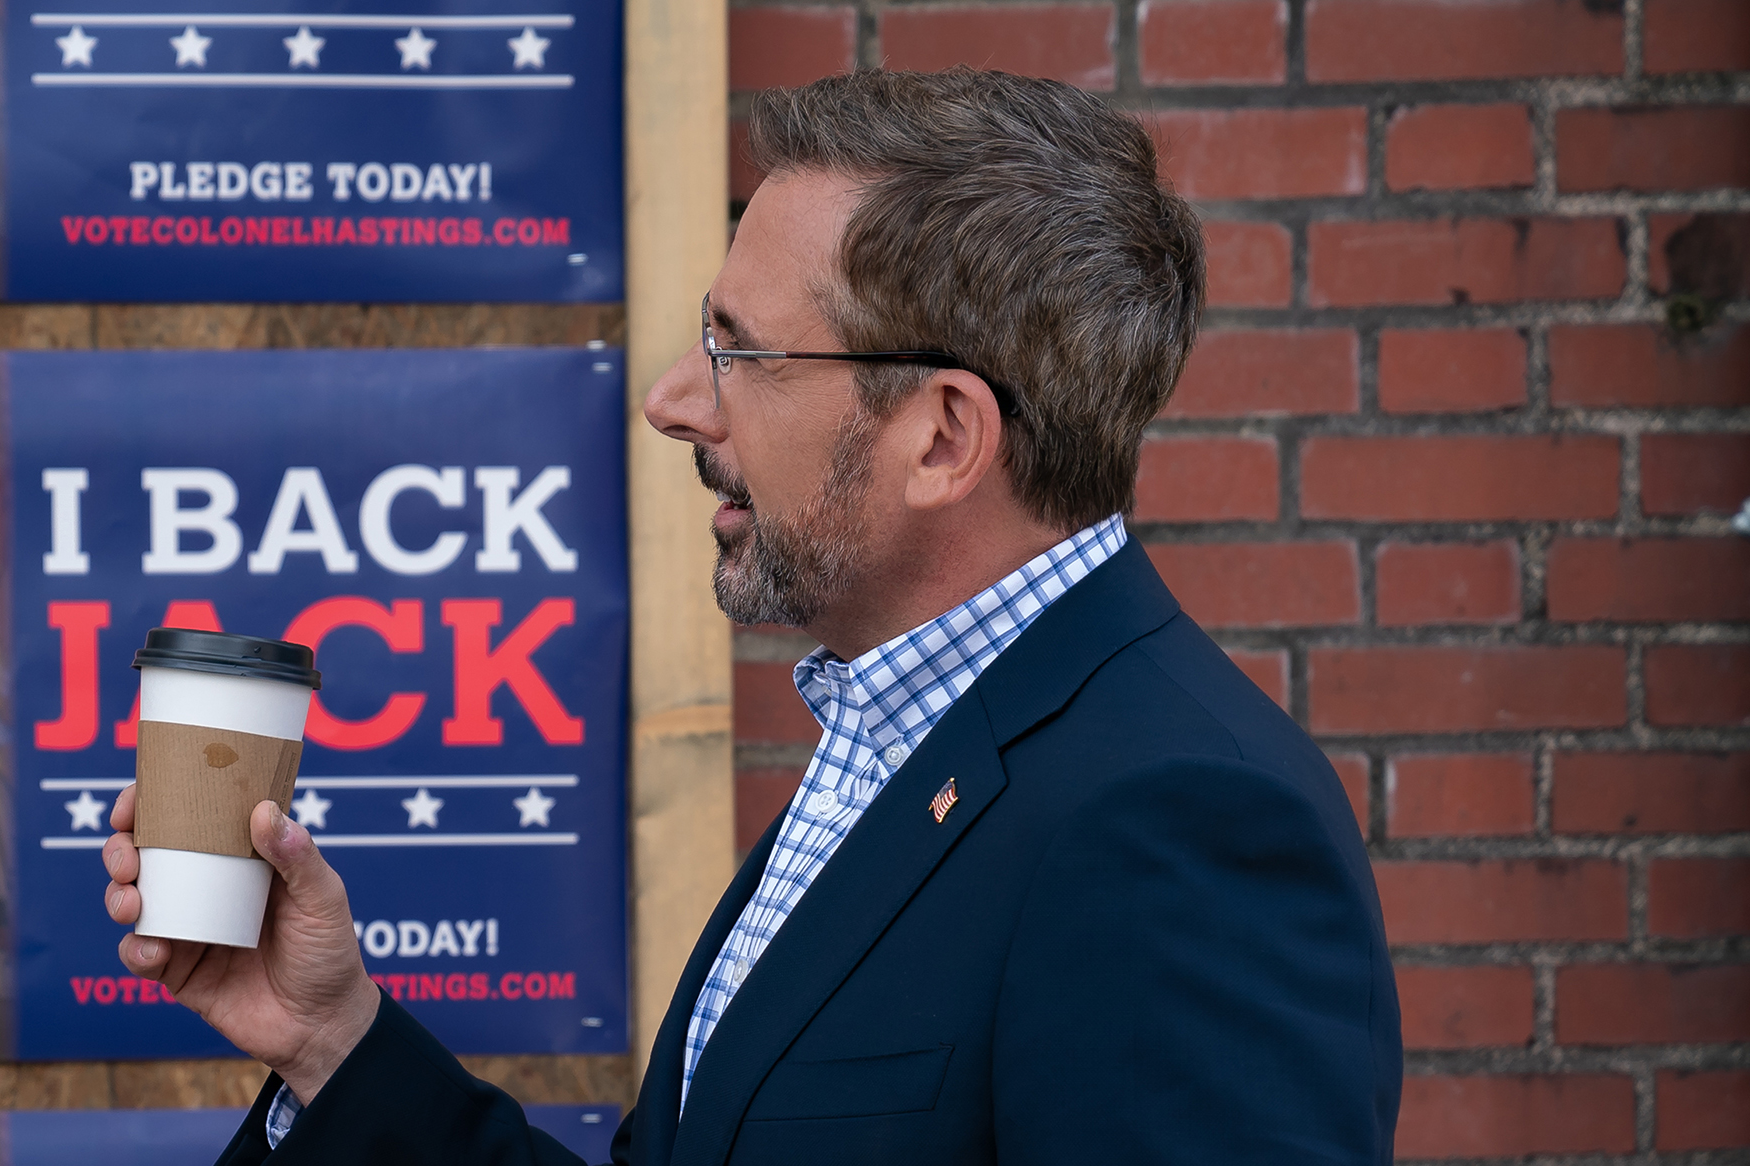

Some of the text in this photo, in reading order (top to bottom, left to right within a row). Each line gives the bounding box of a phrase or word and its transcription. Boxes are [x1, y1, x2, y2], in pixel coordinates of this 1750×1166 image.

[129, 162, 491, 201] PLEDGE TODAY!
[61, 216, 570, 246] VOTECOLONELHASTINGS.COM
[41, 464, 579, 577] I BACK
[353, 918, 499, 959] ODAY!
